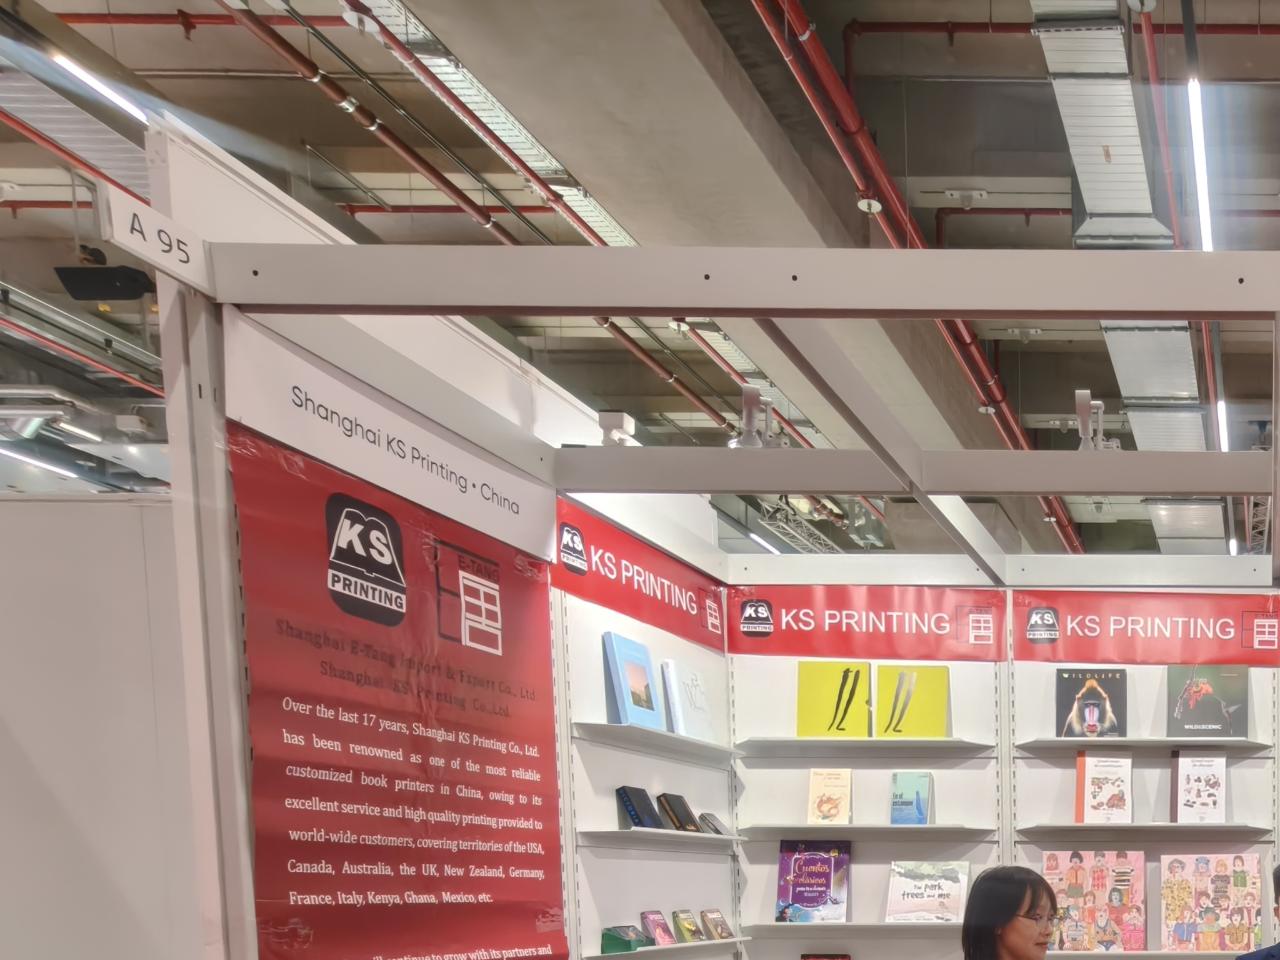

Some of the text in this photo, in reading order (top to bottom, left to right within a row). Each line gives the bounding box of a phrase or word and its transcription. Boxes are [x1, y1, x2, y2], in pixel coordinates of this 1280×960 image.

[130, 213, 189, 264] A 95
[291, 385, 519, 514] Shanghai KS Printing China
[336, 516, 392, 565] KS
[562, 529, 584, 551] KS
[329, 573, 405, 612] PRINTING
[591, 546, 697, 615] KS PRINTING
[745, 604, 768, 617] KS
[782, 609, 949, 633] KS PRINTING
[1031, 612, 1055, 626] KS
[1067, 616, 1235, 639] KS PRINTING
[283, 697, 539, 757] Over the last 17 years, Shanghai KS Printing Co., Ltd.
[283, 729, 540, 781] has been renowned as one of the most reliable
[286, 763, 542, 805] customized book printers in China, owing to its
[285, 797, 542, 829] excellent service and high quality printing provided to
[289, 828, 544, 854] world-wide customers, covering territories of the USA,
[288, 859, 544, 880] Canada, Australia, the UK, New Zealand, Germany,
[289, 891, 493, 907] France, Italy, Kenya, Ghana, Mexico, etc.
[902, 891, 925, 900] trees
[468, 949, 490, 960] with
[490, 946, 501, 959] its
[503, 946, 536, 960] partners
[537, 944, 552, 955] and
